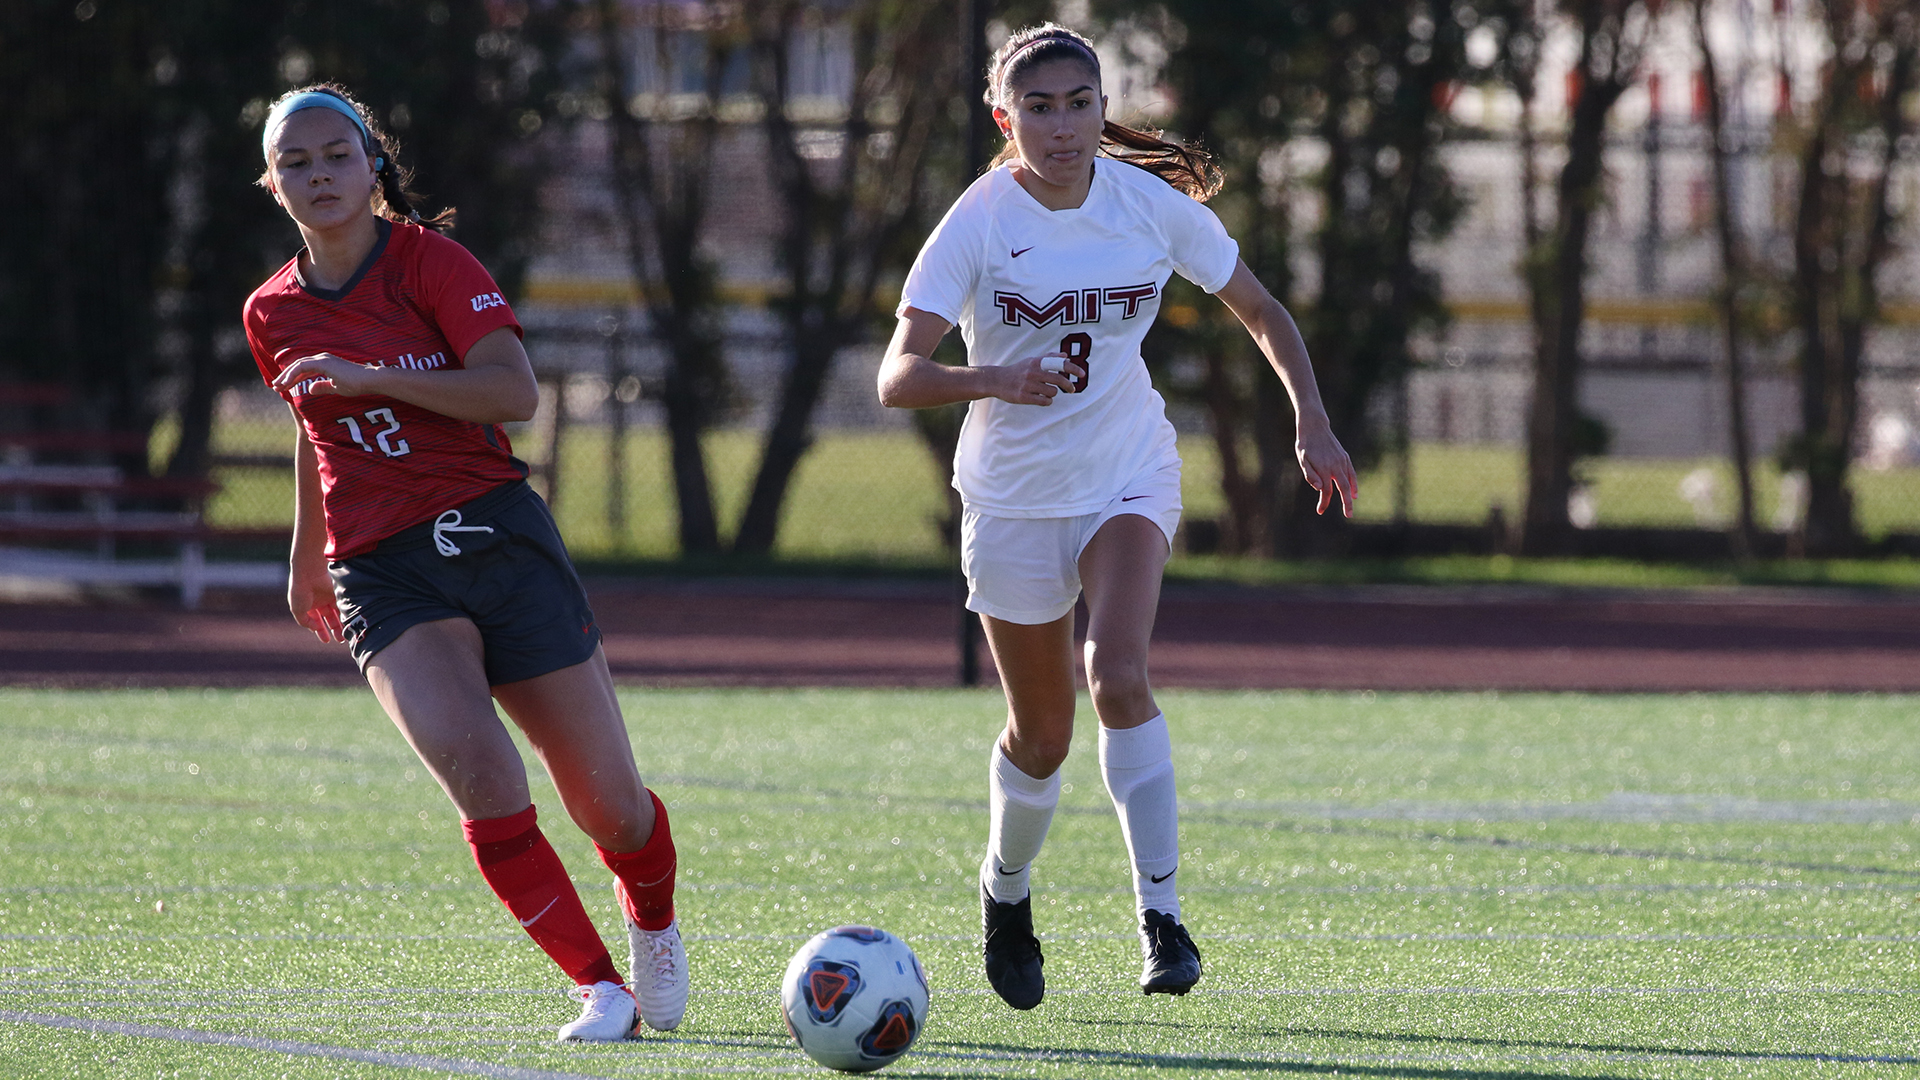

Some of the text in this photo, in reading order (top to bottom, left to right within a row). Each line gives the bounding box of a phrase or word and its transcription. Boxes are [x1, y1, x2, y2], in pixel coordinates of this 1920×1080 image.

[470, 292, 506, 312] UAA
[994, 281, 1158, 329] MIT
[365, 351, 447, 371] llon
[1059, 332, 1092, 394] 8
[336, 407, 411, 458] 12
